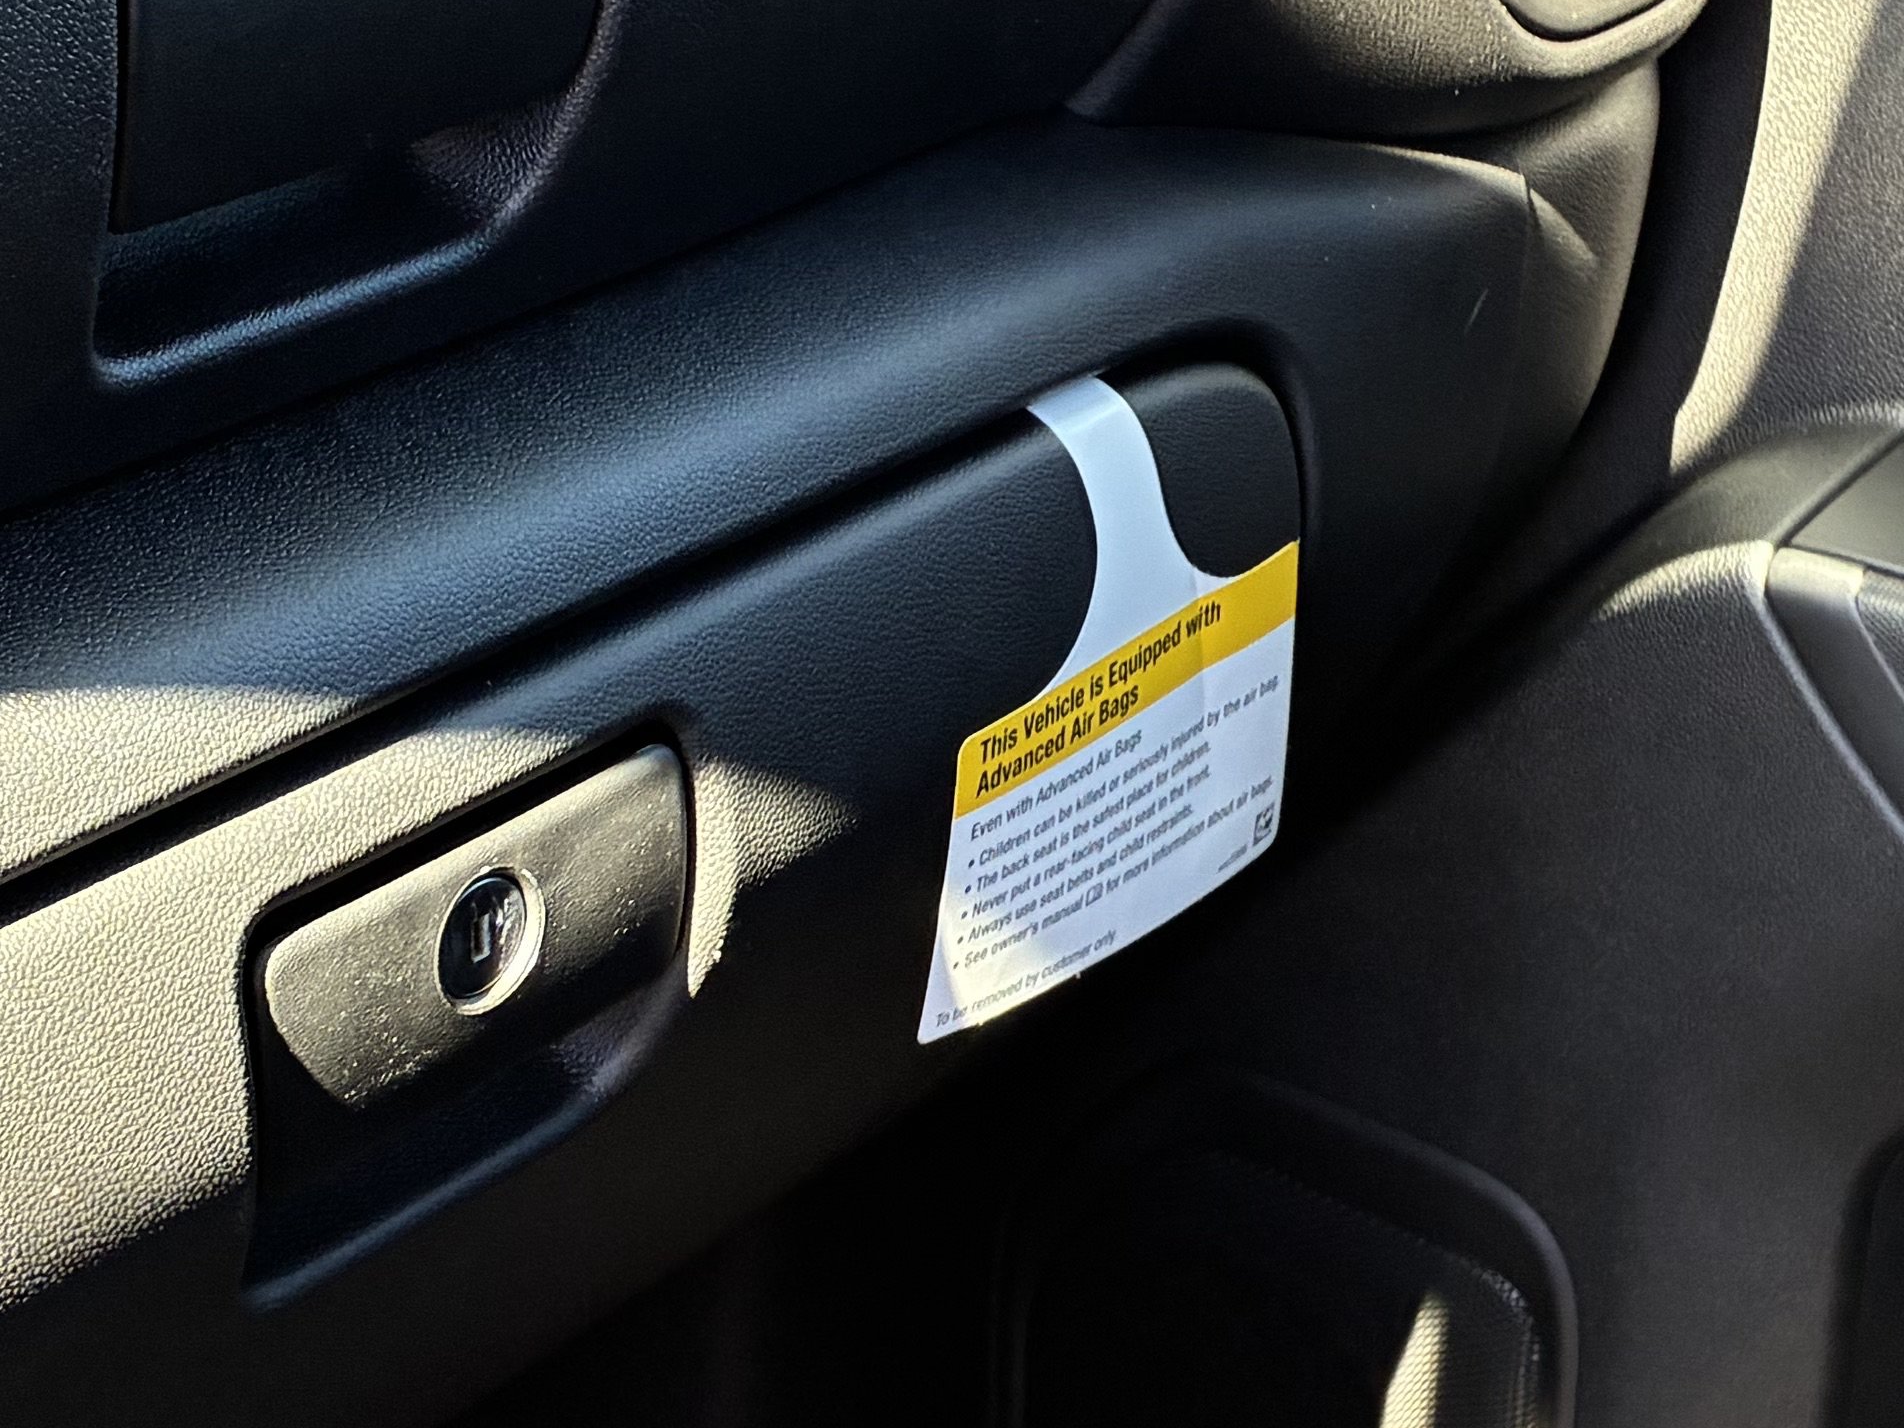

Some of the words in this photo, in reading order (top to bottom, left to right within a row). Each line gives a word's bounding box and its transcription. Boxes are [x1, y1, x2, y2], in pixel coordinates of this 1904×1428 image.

[975, 724, 1067, 800] Advanced
[1069, 711, 1095, 745] Air
[1098, 684, 1139, 727] Bags
[980, 727, 1018, 765] This
[1023, 686, 1085, 740] Vehicle
[1089, 674, 1104, 701] is
[1108, 620, 1182, 689] Equipped
[1185, 600, 1222, 639] with
[970, 813, 1003, 842] Even
[1005, 795, 1034, 823] with
[1035, 756, 1094, 807] Advanced
[1095, 748, 1113, 771] Air
[1114, 729, 1143, 759] Bags
[976, 870, 999, 893] The
[1000, 852, 1030, 881] back
[1032, 835, 1058, 864] seat
[1059, 831, 1070, 848] is
[1072, 819, 1091, 841] the
[1155, 768, 1170, 789] for
[978, 828, 1031, 867] Children
[1033, 814, 1056, 838] can
[1057, 804, 1073, 824] be
[1075, 781, 1107, 813] killed
[1108, 775, 1121, 793] or
[1122, 743, 1169, 786] seriously
[1206, 709, 1221, 728] by
[1222, 697, 1242, 719] the
[1242, 687, 1258, 708] air
[964, 947, 989, 969] See
[1105, 874, 1122, 895] for
[1206, 798, 1235, 829] about
[1235, 791, 1249, 810] air
[967, 911, 1013, 944] Always
[1014, 898, 1038, 921] use
[1039, 881, 1066, 909] seat
[1096, 850, 1118, 876] and
[971, 890, 1009, 919] Never
[1009, 875, 1032, 903] put
[1032, 872, 1042, 888] a
[1133, 800, 1157, 829] seat
[1157, 795, 1169, 812] in
[1169, 783, 1185, 804] the
[935, 1011, 951, 1028] To
[951, 1005, 968, 1022] be
[971, 976, 1024, 1013] removed
[1024, 971, 1041, 989] by
[1041, 942, 1093, 980] customer
[1093, 929, 1117, 952] only
